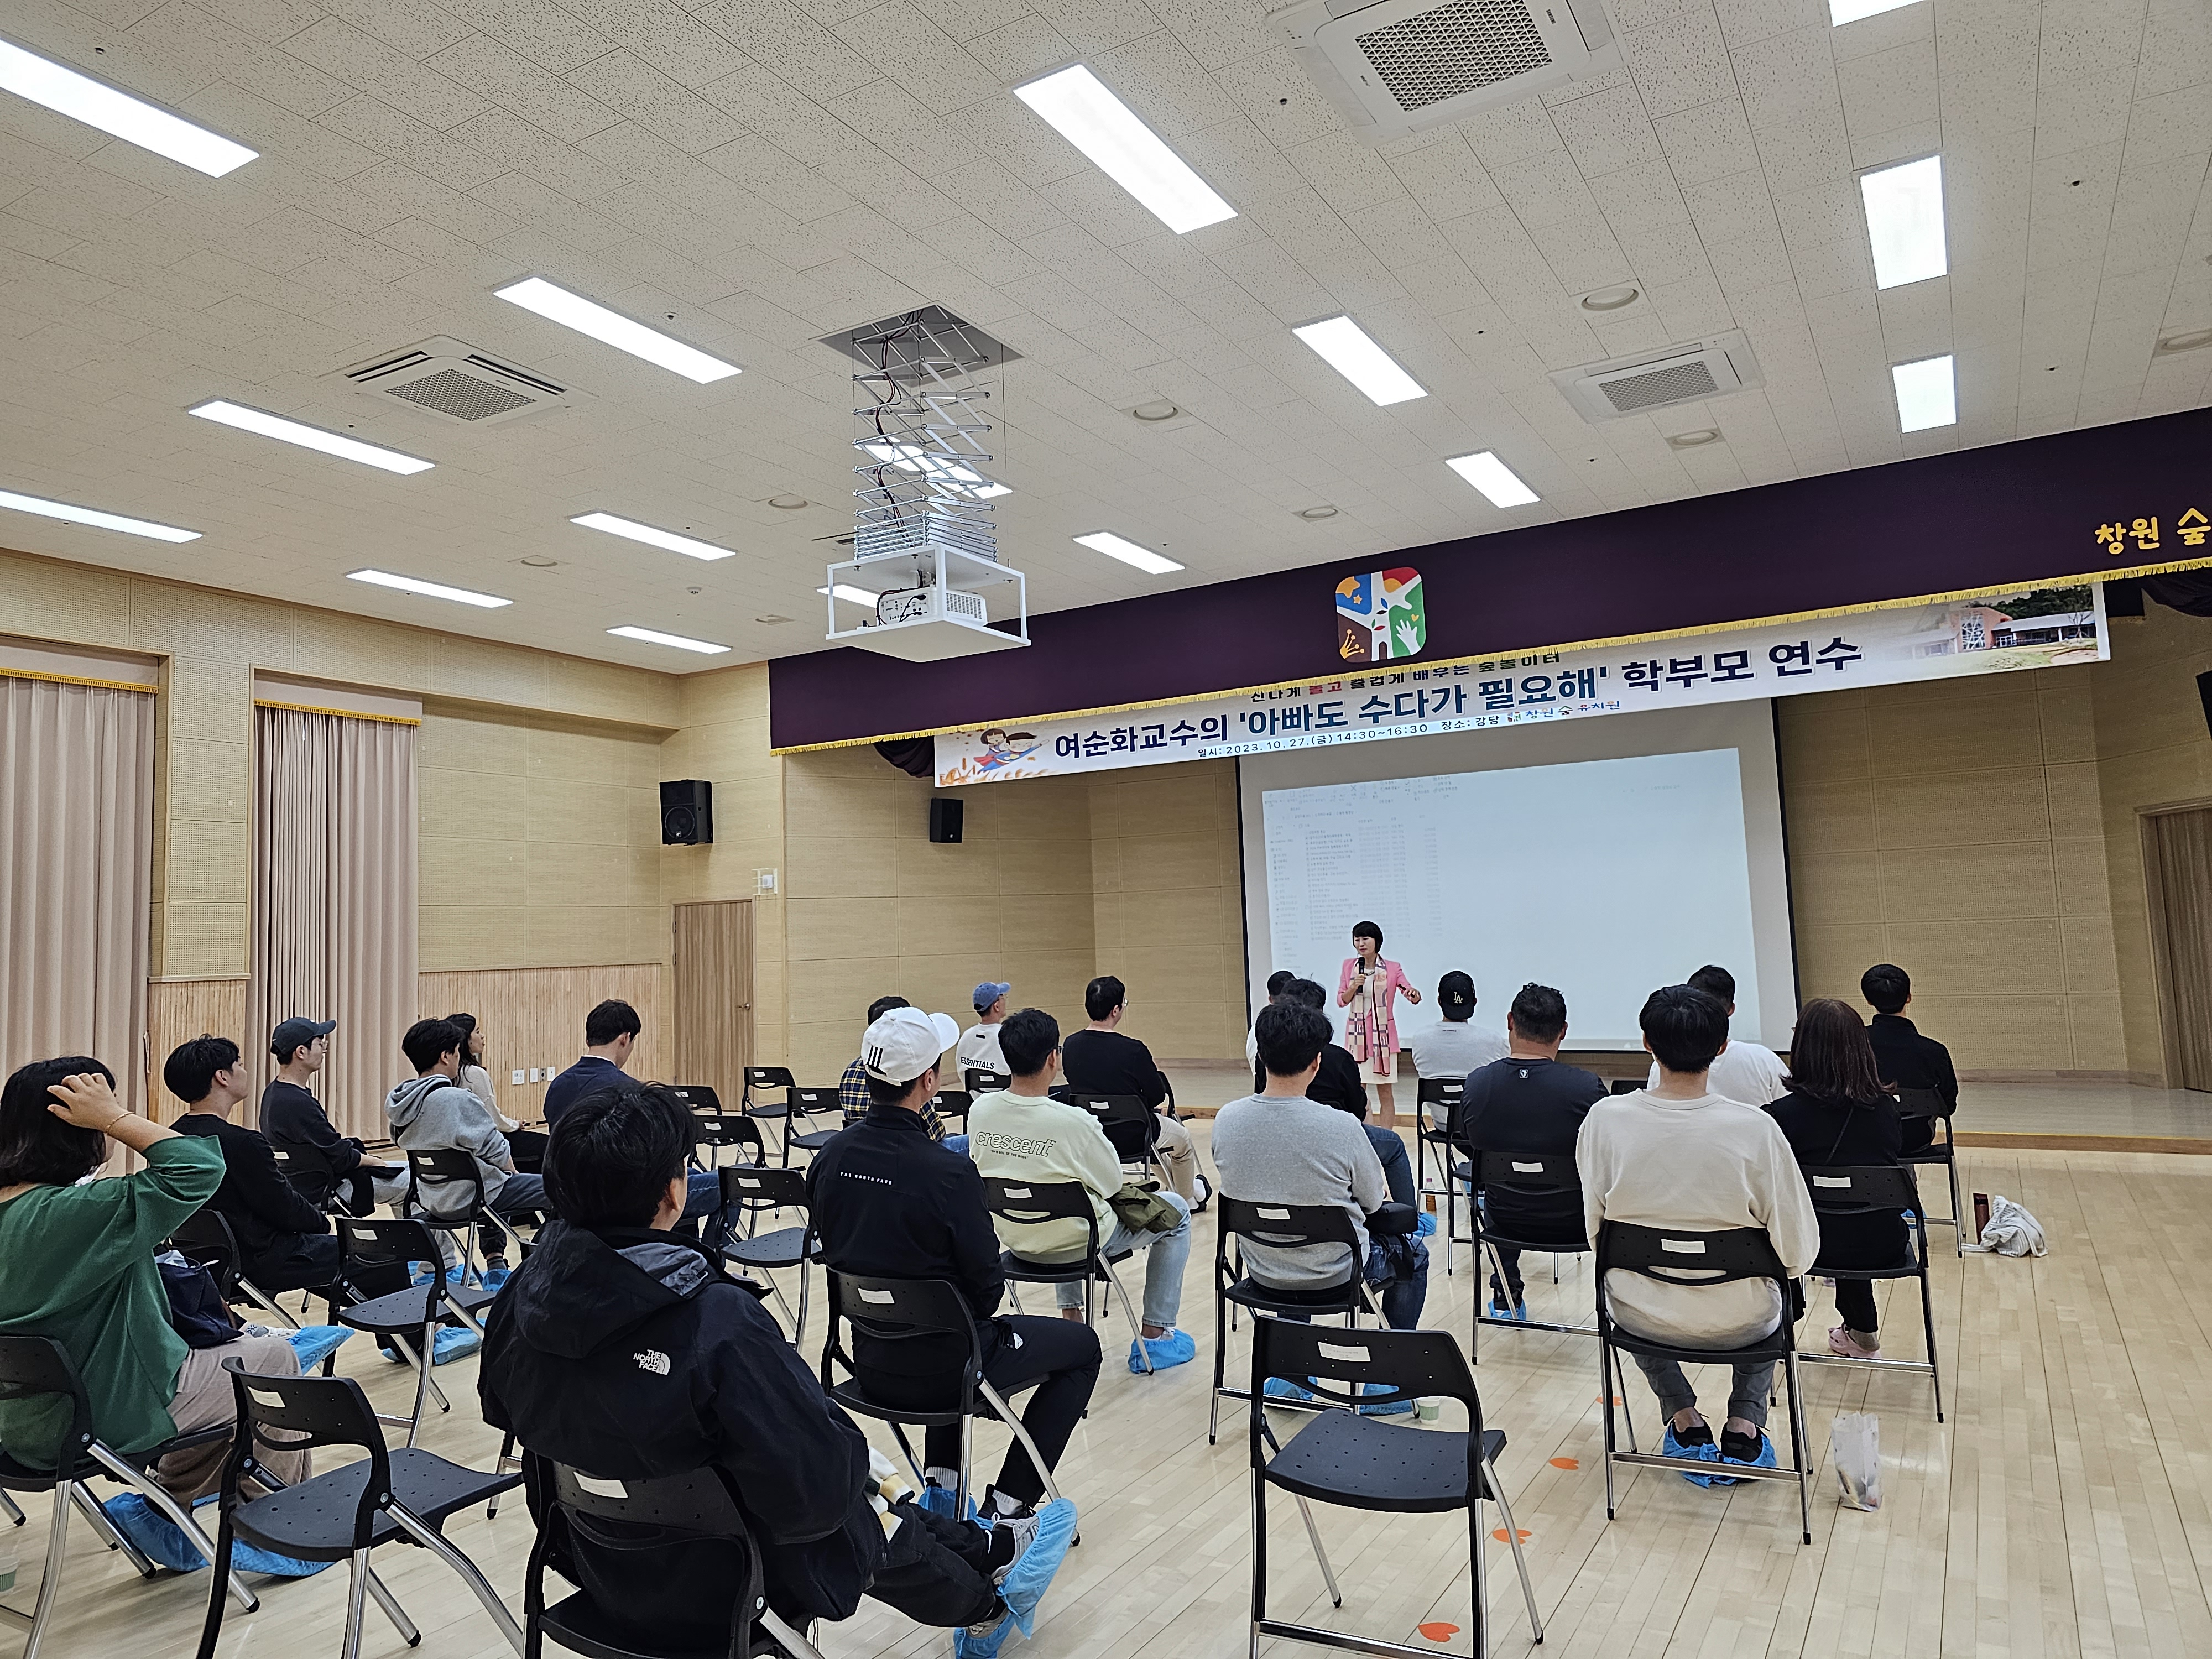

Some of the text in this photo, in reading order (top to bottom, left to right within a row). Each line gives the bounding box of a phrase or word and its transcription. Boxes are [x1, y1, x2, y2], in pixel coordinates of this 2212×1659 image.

[2094, 507, 2211, 555] 창원 숲
[1055, 637, 1863, 759] 여순화교수의 '아빠도 수다가 필요해' 학부모 연수
[1441, 719, 1470, 731] 장소:
[1475, 715, 1500, 727] 강당
[1525, 707, 1554, 719] 창원
[1557, 705, 1574, 716] 숲
[1577, 700, 1620, 712] 유치원
[961, 1056, 995, 1070] ESSENTIALS
[975, 1131, 1055, 1157] crescent
[633, 1352, 660, 1366] NORTH
[646, 1349, 662, 1359] THE
[638, 1361, 658, 1372] FACE
